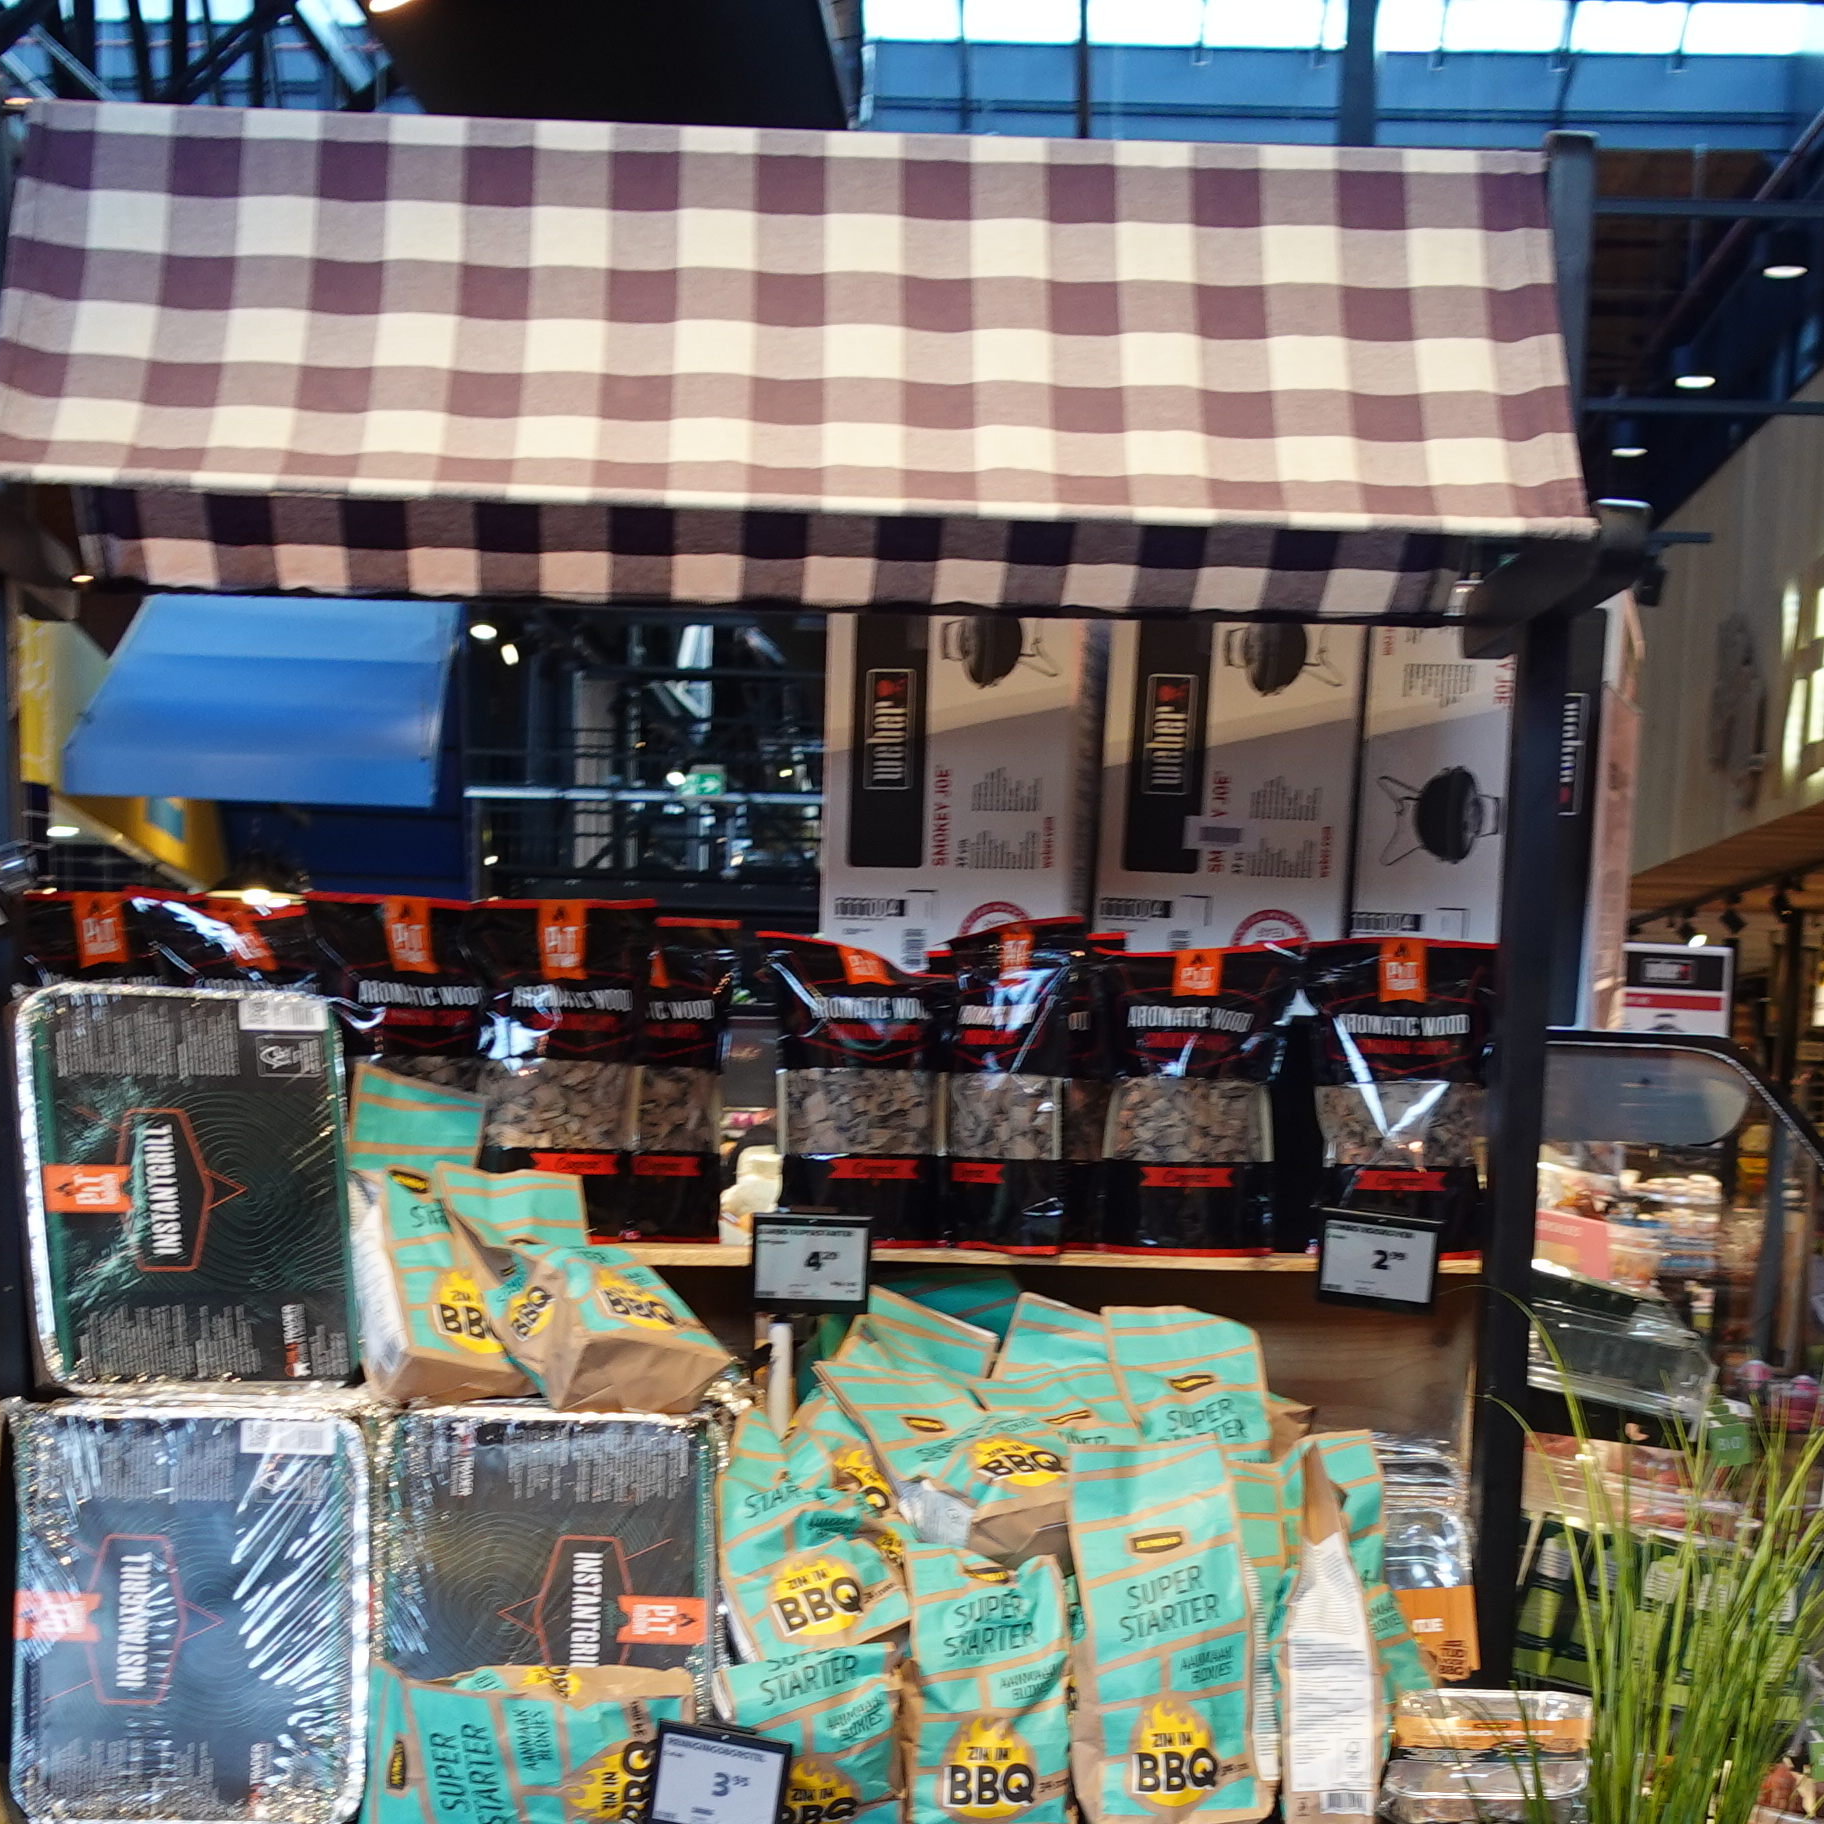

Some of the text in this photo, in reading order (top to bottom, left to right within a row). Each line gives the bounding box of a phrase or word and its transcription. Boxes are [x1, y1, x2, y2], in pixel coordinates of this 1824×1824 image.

[865, 700, 907, 781] weber
[1146, 705, 1188, 785] weber
[933, 802, 952, 866] SMOKEY
[1128, 1005, 1254, 1032] AROMATIC WOOD
[1338, 1013, 1470, 1036] AROMATIC WOOD
[142, 1123, 183, 1257] INSTANTGRILL
[773, 1577, 863, 1638] BBQ
[955, 1594, 1026, 1629] SUPER
[1127, 1566, 1206, 1610] SUPER
[115, 1550, 155, 1689] INSTANTGRILL
[944, 1622, 1036, 1658] STARTER
[1120, 1594, 1222, 1643] STARTER
[759, 1654, 860, 1707] STARTER
[1152, 1733, 1174, 1747] ZIN
[430, 1732, 464, 1813] SUPER
[945, 1764, 1036, 1808] BBQ
[1133, 1748, 1218, 1794] BBQ
